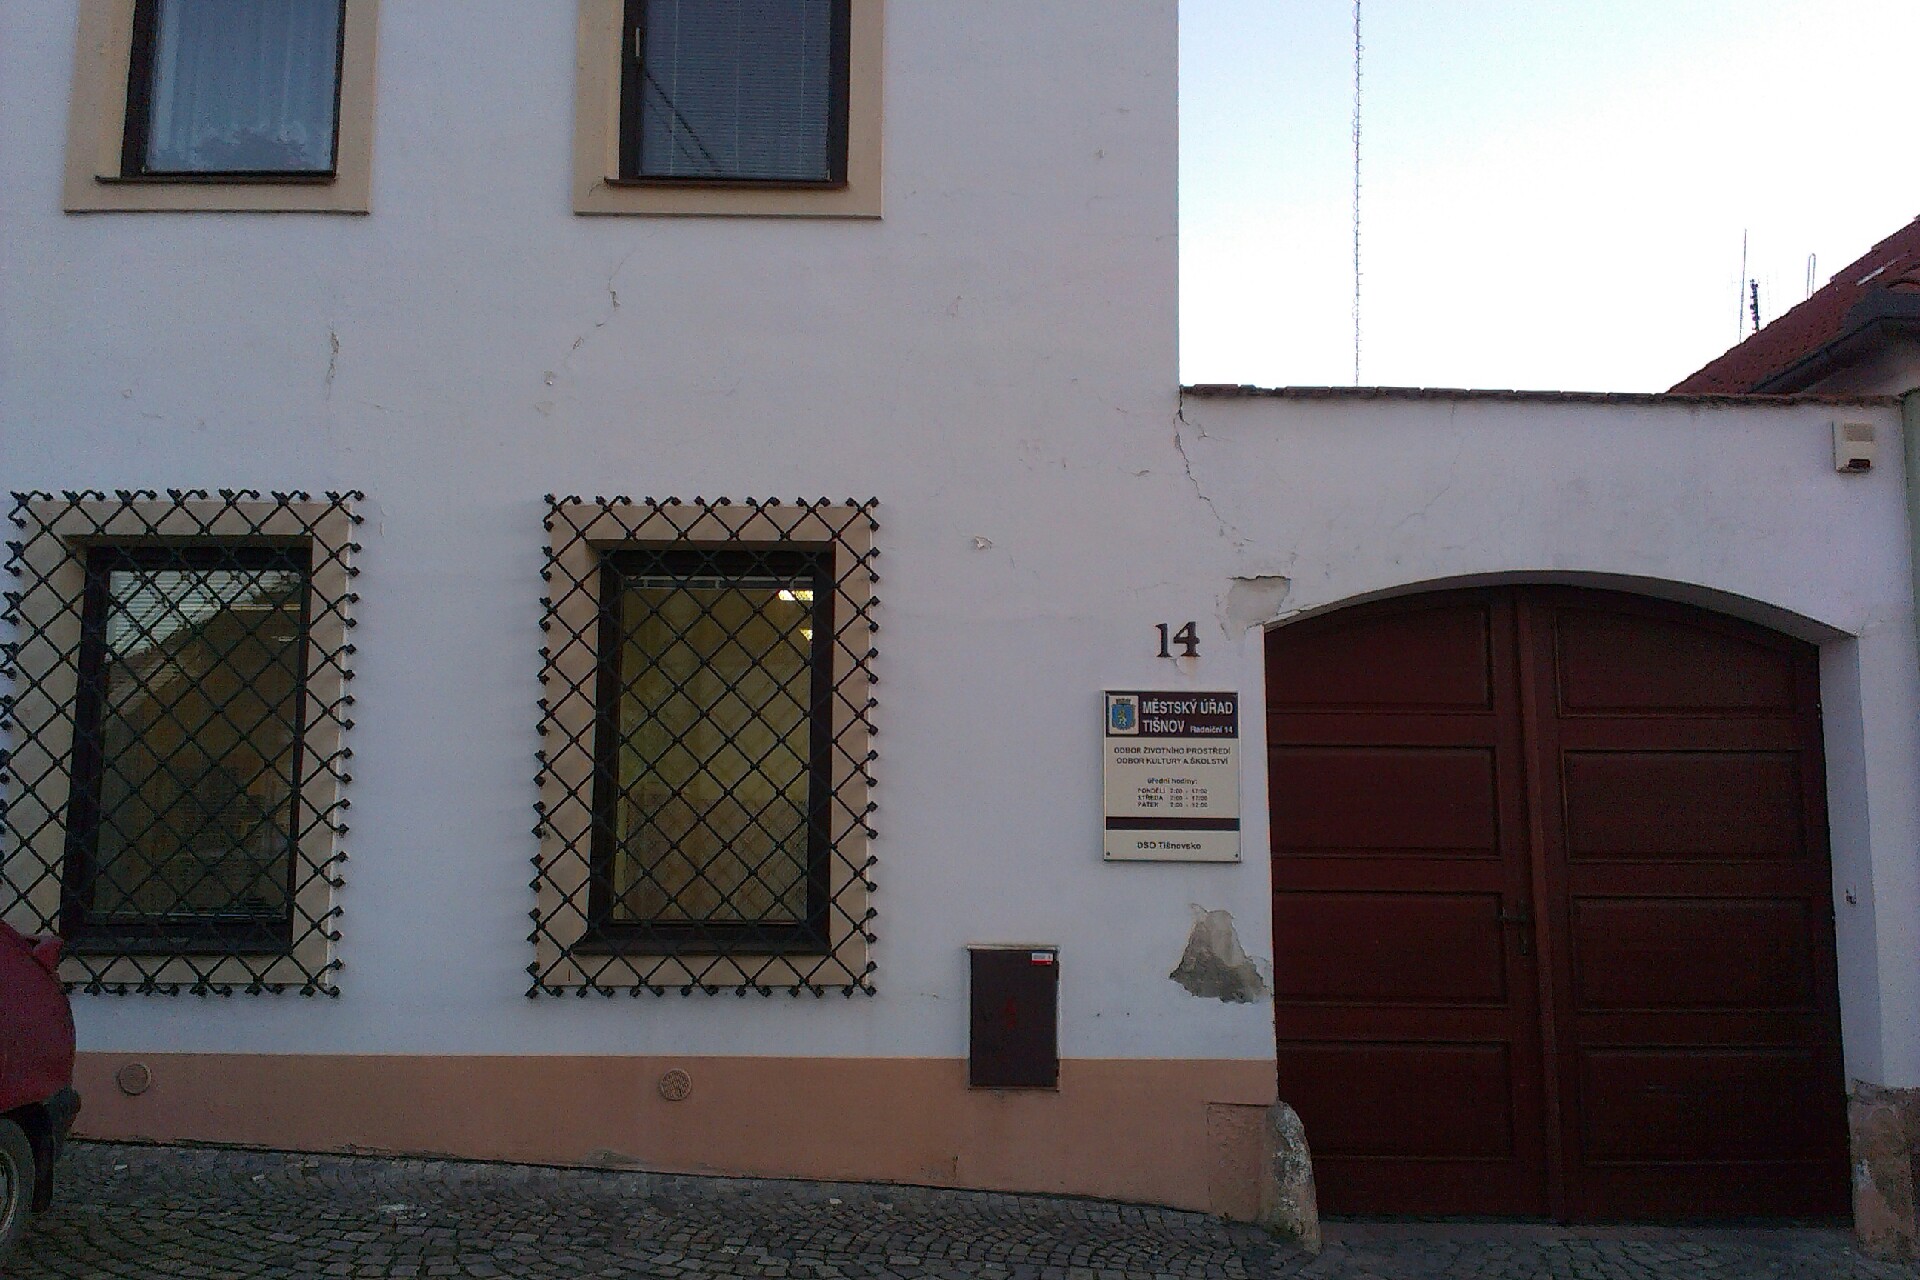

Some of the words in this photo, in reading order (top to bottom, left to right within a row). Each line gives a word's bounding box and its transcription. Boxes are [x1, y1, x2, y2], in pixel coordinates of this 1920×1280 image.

[1155, 621, 1201, 658] 14
[1142, 698, 1198, 715] MĚSTSKÝ
[1200, 698, 1234, 716] ÚŘAD
[1142, 717, 1185, 733] TIŠNOV
[1224, 726, 1233, 734] 14
